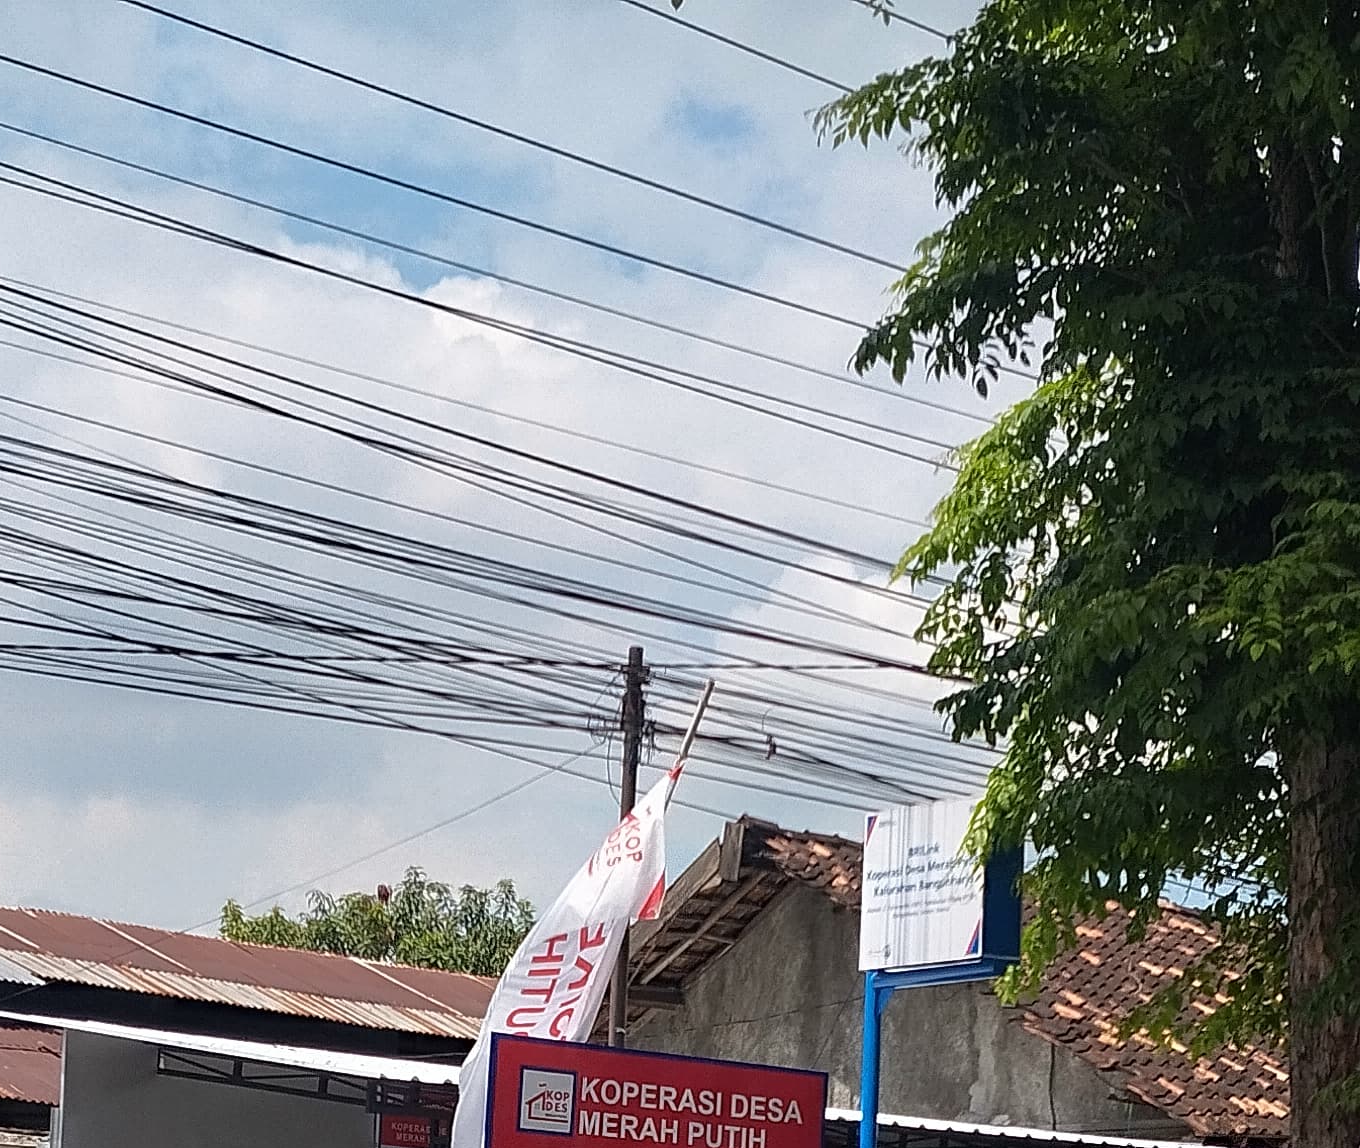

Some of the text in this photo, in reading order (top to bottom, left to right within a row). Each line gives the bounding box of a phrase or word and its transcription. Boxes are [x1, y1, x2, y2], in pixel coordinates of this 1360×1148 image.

[546, 1090, 570, 1101] KOP
[581, 1076, 803, 1125] KOPERASI DESA
[546, 1101, 568, 1113] DES
[578, 1111, 679, 1144] MERAH
